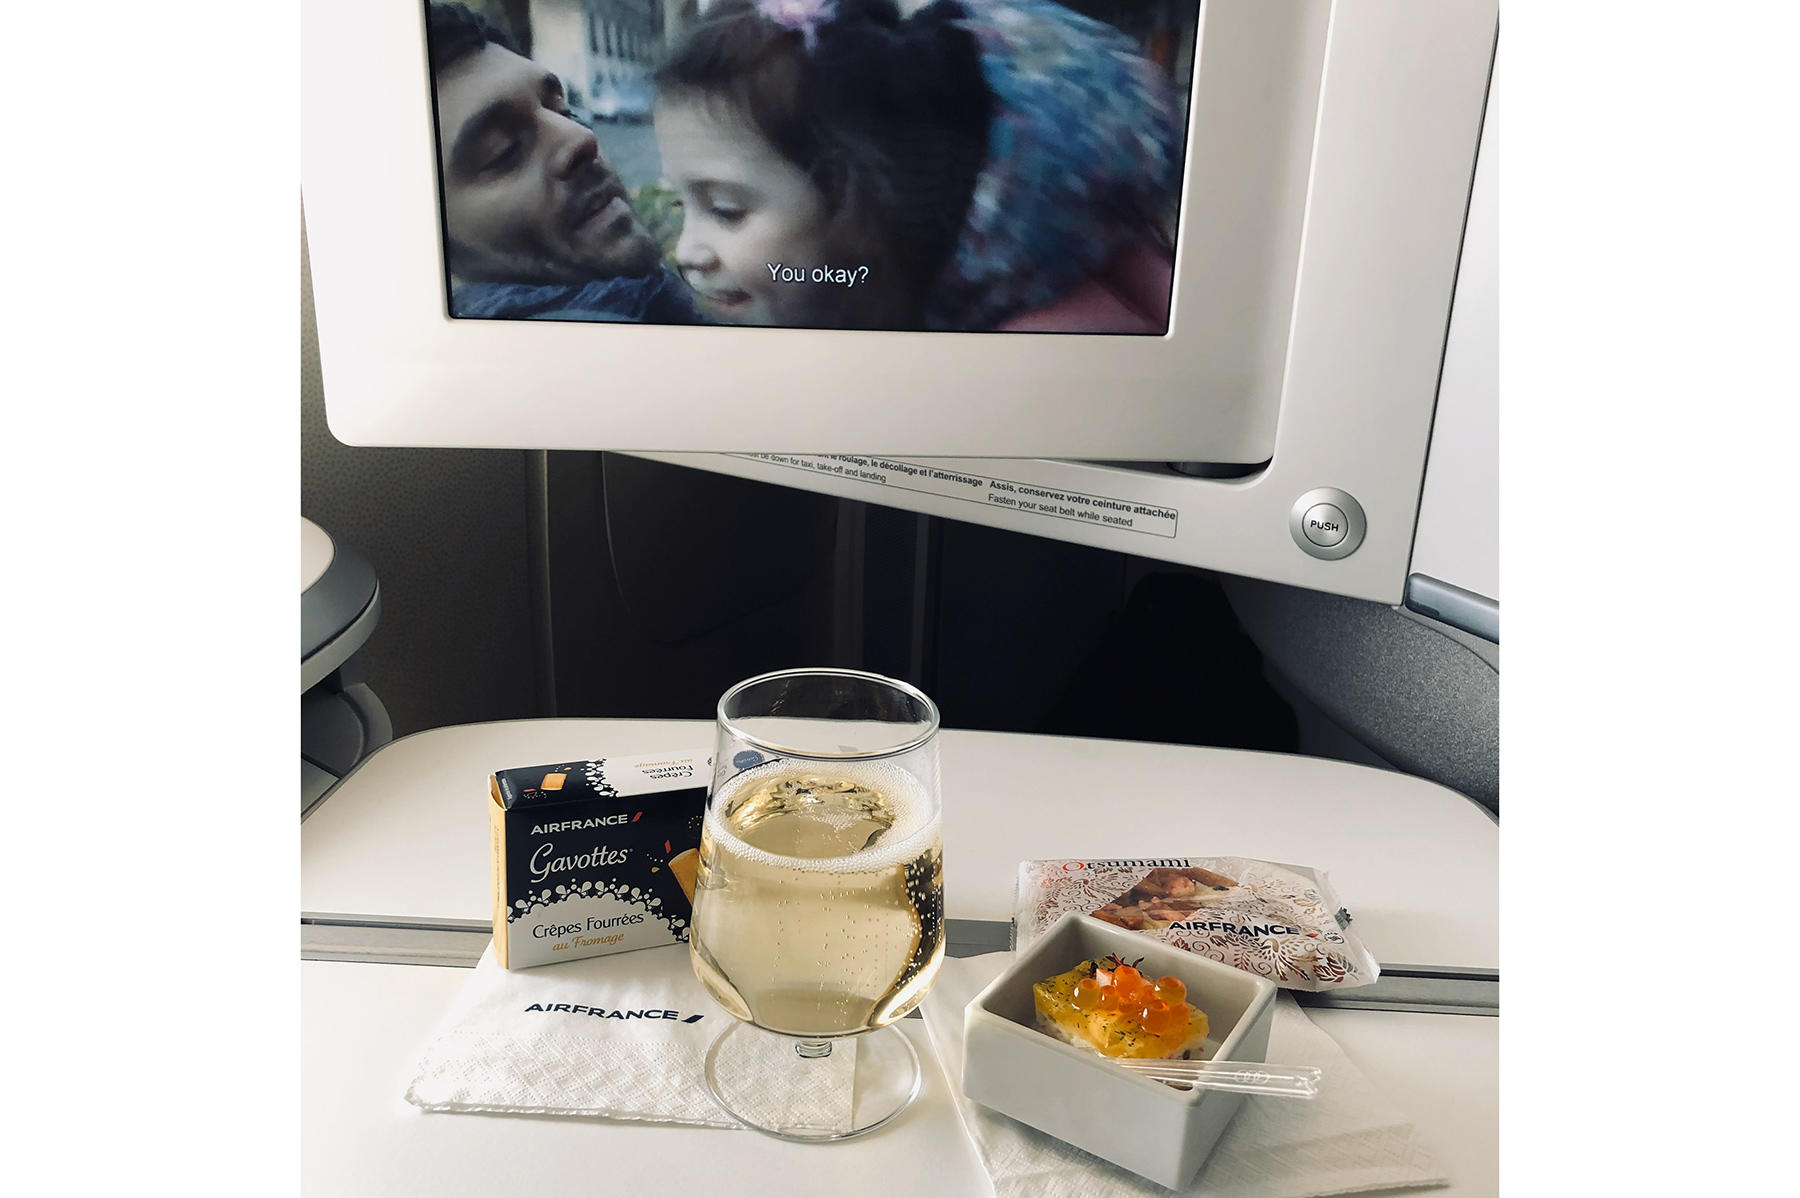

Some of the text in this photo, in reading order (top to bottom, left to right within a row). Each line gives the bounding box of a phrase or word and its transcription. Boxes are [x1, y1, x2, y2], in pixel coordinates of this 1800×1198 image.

[767, 263, 869, 288] You okay?
[770, 454, 789, 464] down
[790, 457, 800, 465] for
[801, 460, 816, 469] taxi,
[817, 462, 843, 473] take-off
[844, 468, 859, 477] and
[860, 470, 887, 483] landing
[871, 459, 879, 467] le
[880, 460, 918, 476] décollage
[919, 468, 928, 477] et
[988, 493, 1133, 527] Fasten your seat belt while seated
[989, 480, 1176, 520] Assis, conservez votre ceinture attachée
[1310, 519, 1339, 532] PUSH
[530, 814, 628, 836] AIRFRANCE
[529, 842, 629, 884] Gavottes
[532, 913, 644, 939] Crêpes Fourrées
[1168, 920, 1299, 938] AIRFRANCE
[552, 932, 625, 952] au Fromage
[524, 1003, 680, 1021] AIRFRANCE
